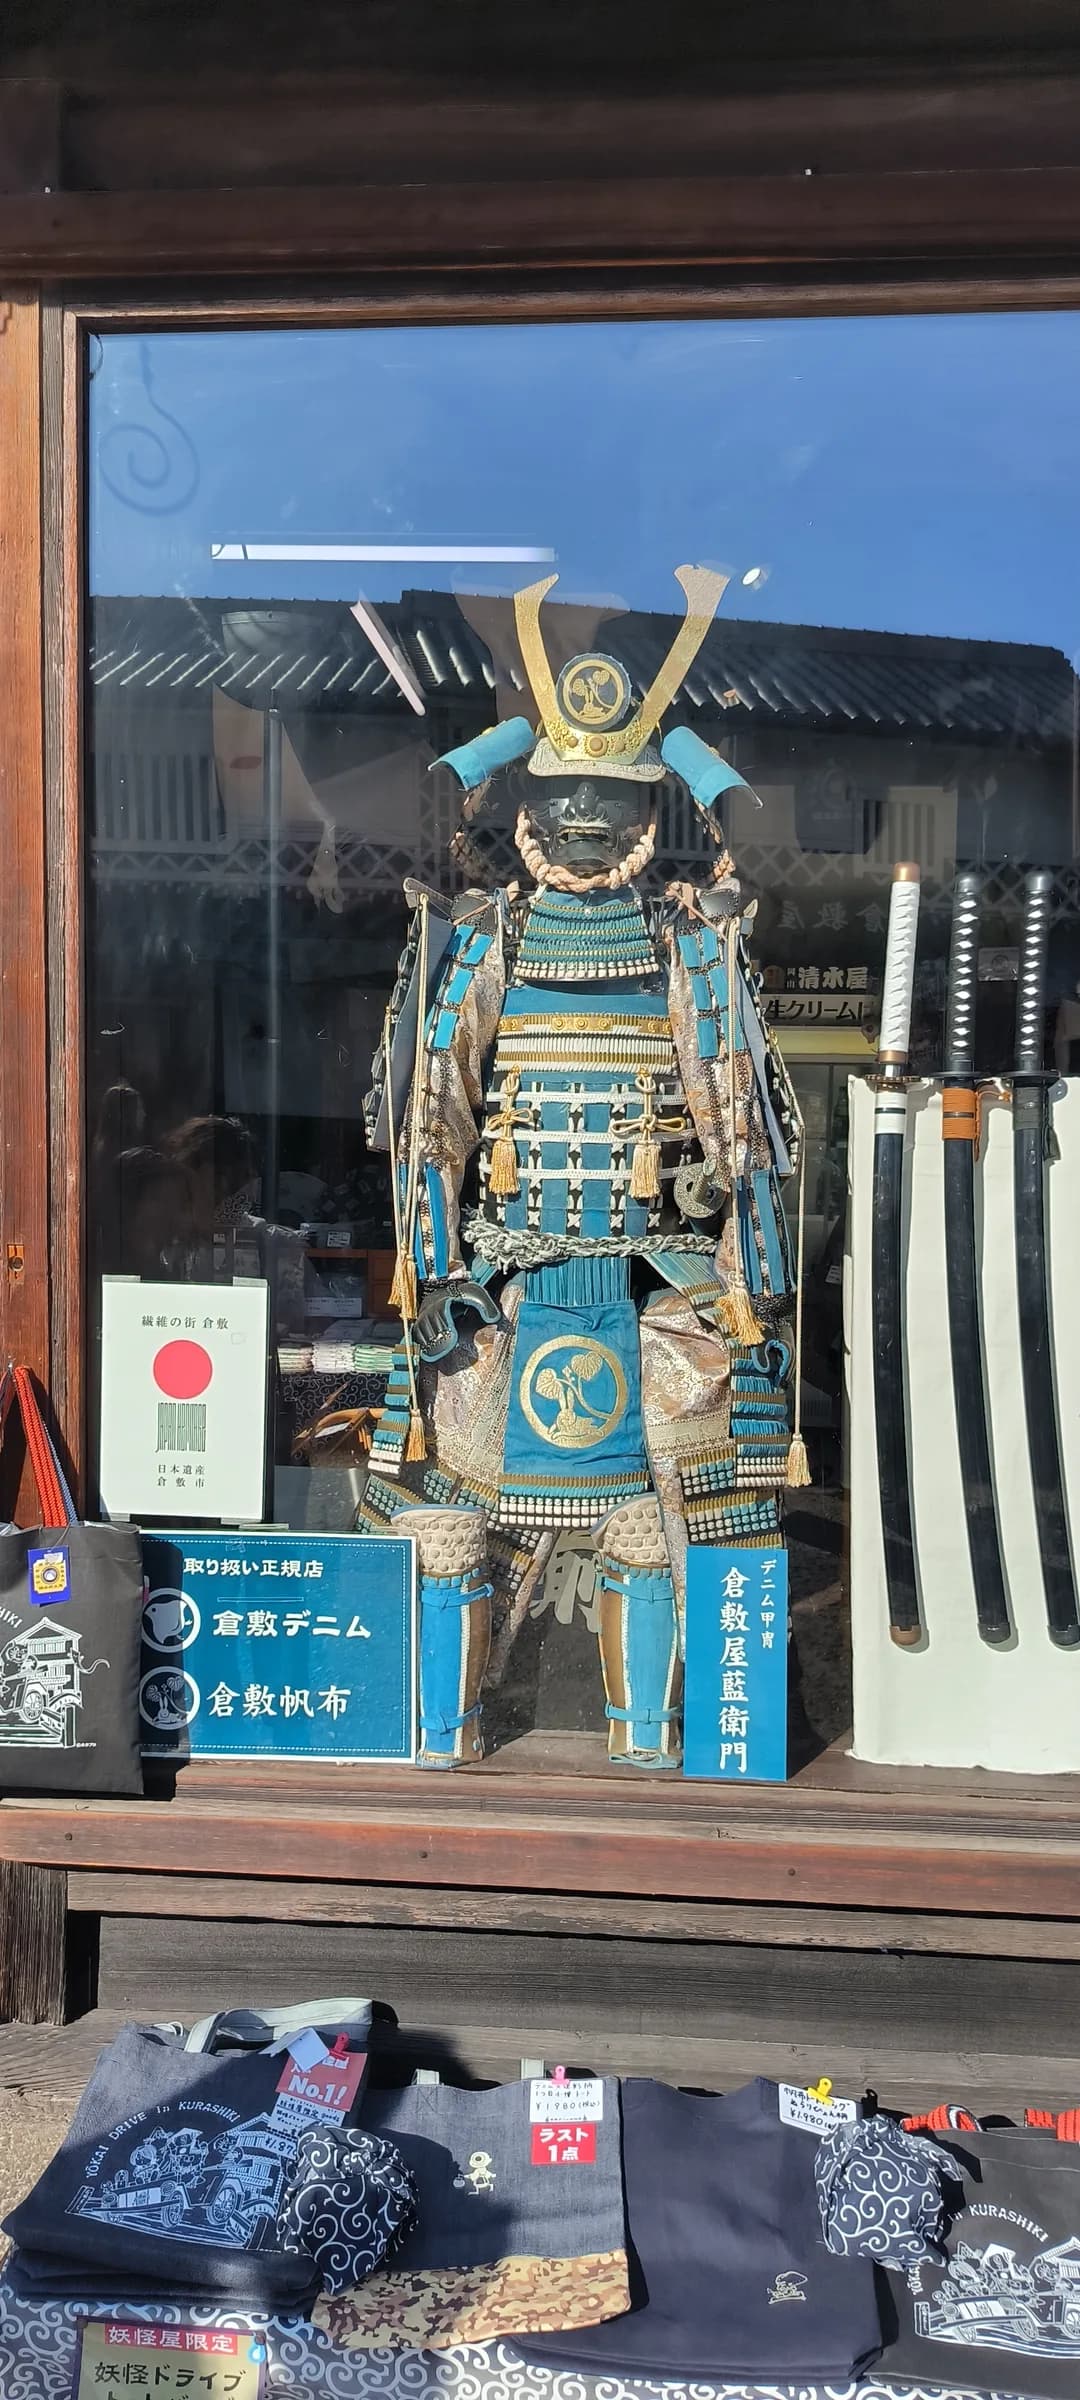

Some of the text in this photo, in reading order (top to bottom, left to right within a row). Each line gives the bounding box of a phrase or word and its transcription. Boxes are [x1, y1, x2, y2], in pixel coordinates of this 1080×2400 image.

[798, 966, 868, 989] 清水屋
[202, 1316, 229, 1330] 倉敷
[157, 1476, 205, 1488] 倉敷市
[158, 1463, 205, 1476] 日本遺産
[183, 1557, 325, 1579] 取り扱い正規店
[760, 1559, 777, 1649] デニム甲冑
[212, 1609, 372, 1640] 倉敷デニム
[718, 1566, 751, 1775] 倉敷屋藍衛門
[206, 1681, 351, 1720] 倉敷帆布
[288, 2074, 347, 2105] No.1!
[109, 2111, 147, 2141] DRIVE
[178, 2100, 241, 2123] KURASHIKI
[539, 2127, 589, 2143] ラスト
[548, 2144, 579, 2162] 1点
[968, 2204, 1049, 2243] KURASHIKI
[108, 2325, 234, 2353] 妖怪屋限定
[94, 2361, 247, 2392] 妖怪ドライブ
